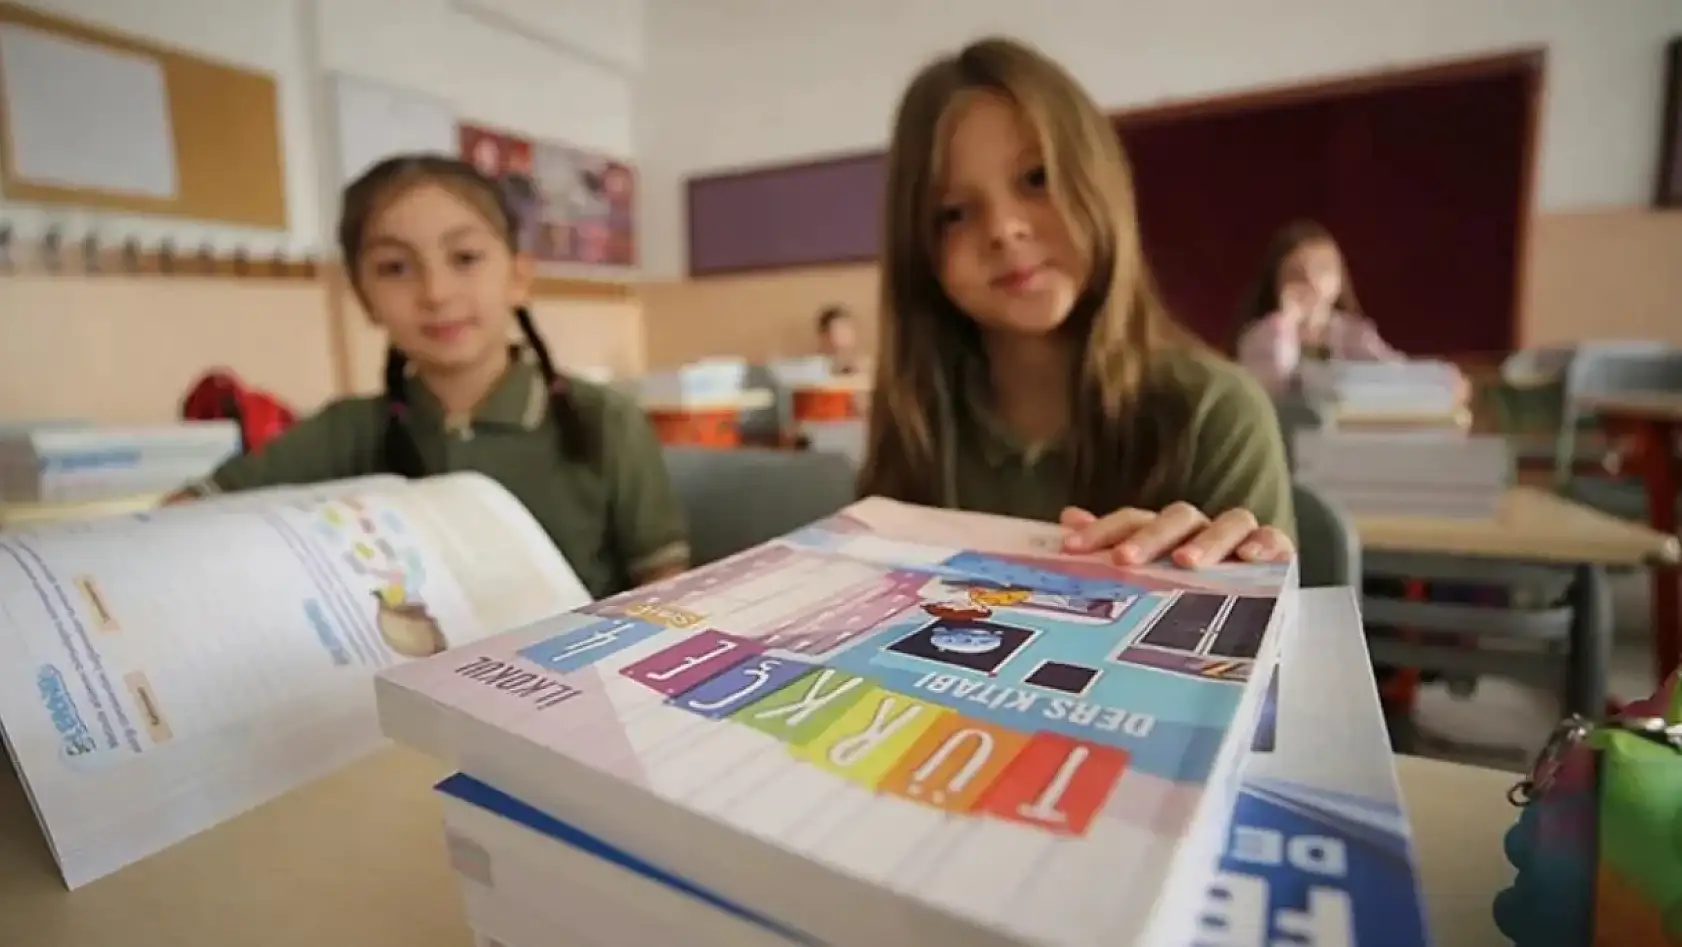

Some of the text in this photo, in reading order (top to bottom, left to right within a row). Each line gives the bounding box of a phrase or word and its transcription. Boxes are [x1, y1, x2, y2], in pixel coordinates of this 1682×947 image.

[552, 622, 636, 663] 4
[646, 639, 1090, 822] TÜRKÇE
[913, 671, 1157, 737] DERS KİTABI
